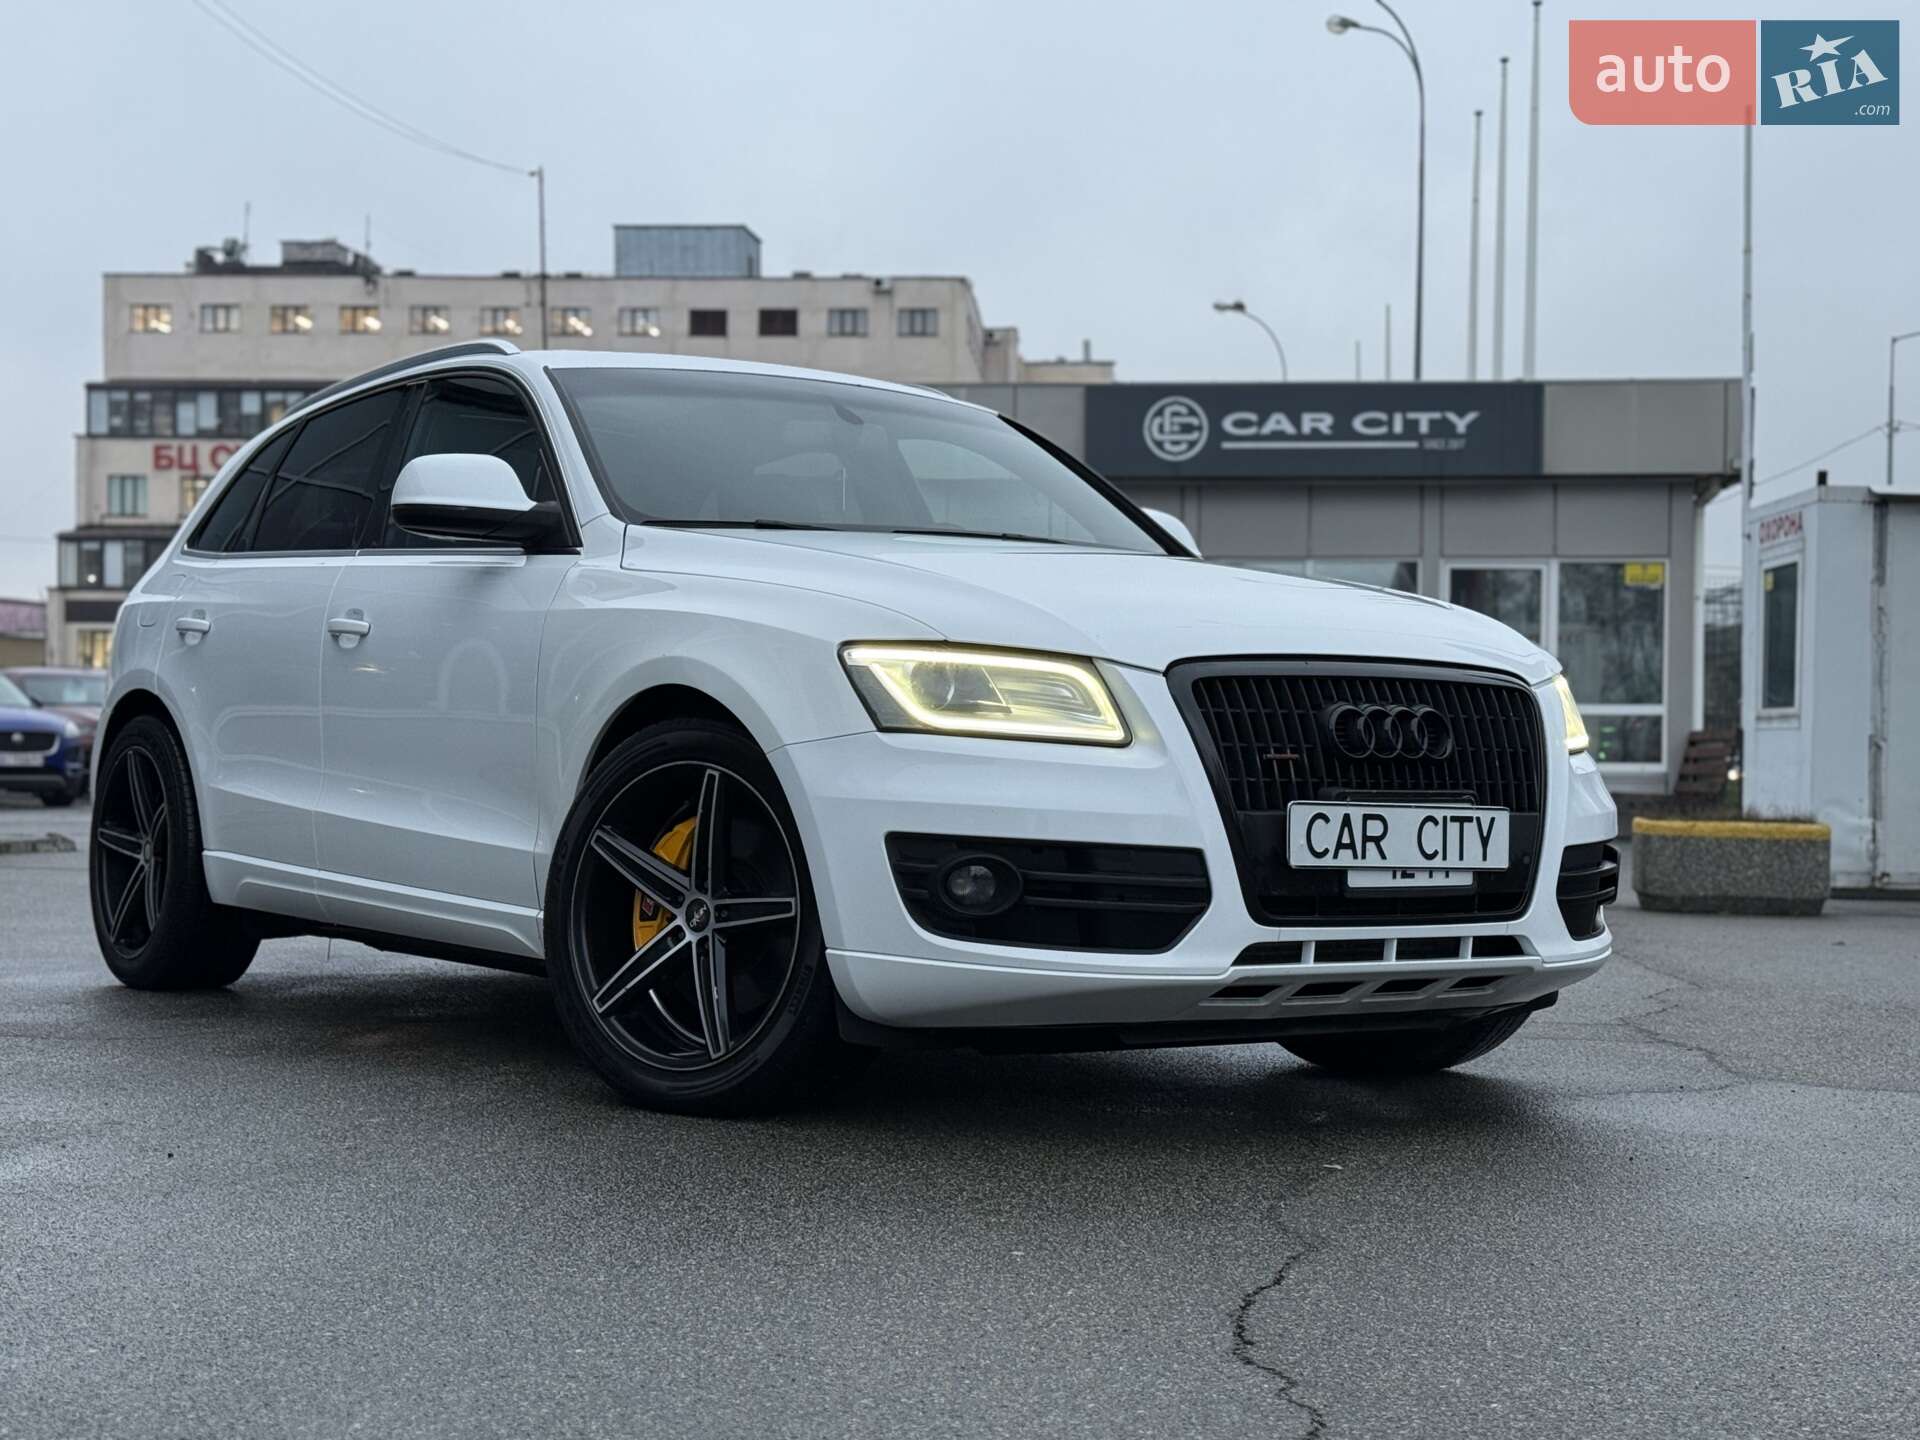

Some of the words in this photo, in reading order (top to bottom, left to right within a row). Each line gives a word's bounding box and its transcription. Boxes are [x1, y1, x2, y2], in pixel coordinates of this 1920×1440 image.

[1221, 411, 1334, 436] CAR
[1351, 411, 1480, 435] CITY
[153, 443, 200, 478] БЦ
[1305, 811, 1389, 860] CAR
[1416, 814, 1496, 862] CITY
